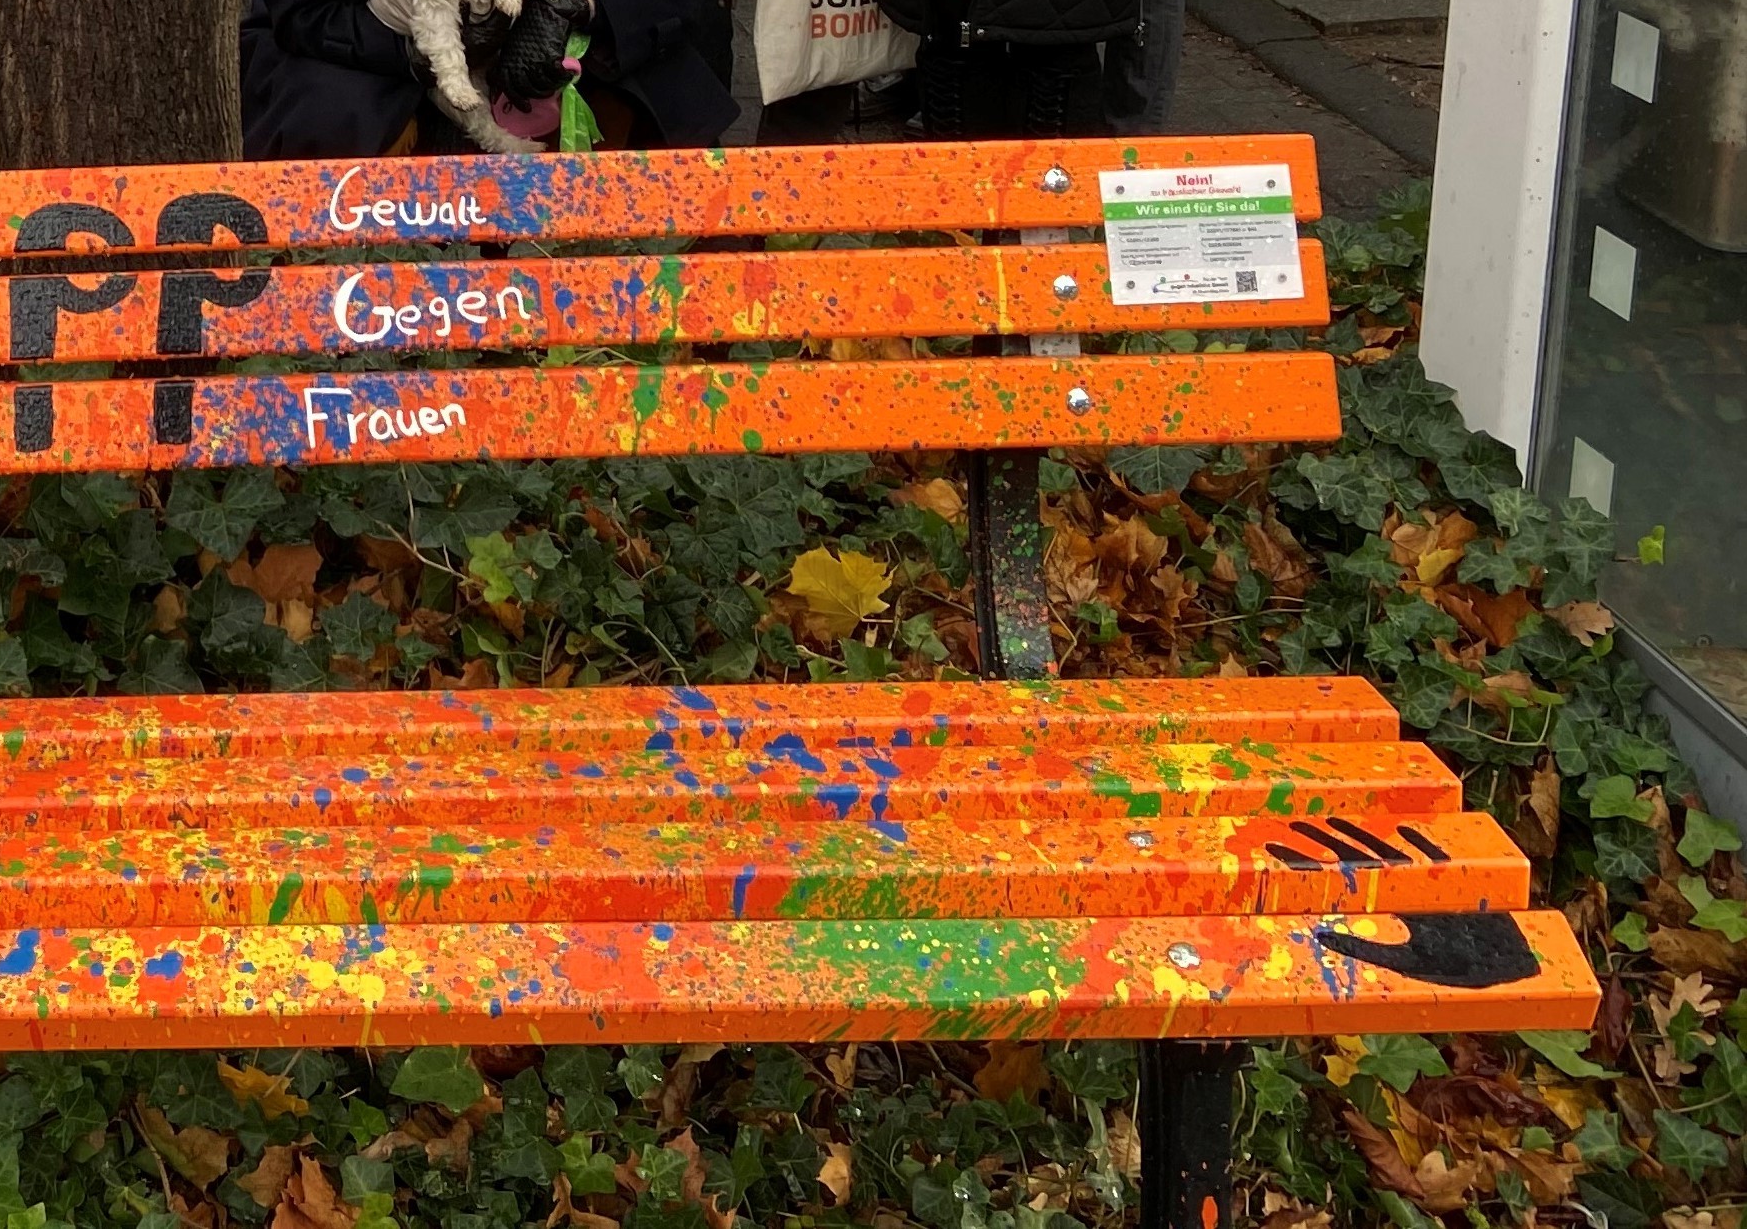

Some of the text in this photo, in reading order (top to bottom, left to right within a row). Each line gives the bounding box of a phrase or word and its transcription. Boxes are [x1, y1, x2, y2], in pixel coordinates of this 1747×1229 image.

[811, 9, 888, 38] BONN.
[329, 166, 487, 231] Gewalt
[1176, 174, 1213, 186] Nein!
[1135, 200, 1261, 216] Wir sind für Sie da!
[333, 272, 532, 343] Gegen
[303, 387, 467, 449] Frauen
